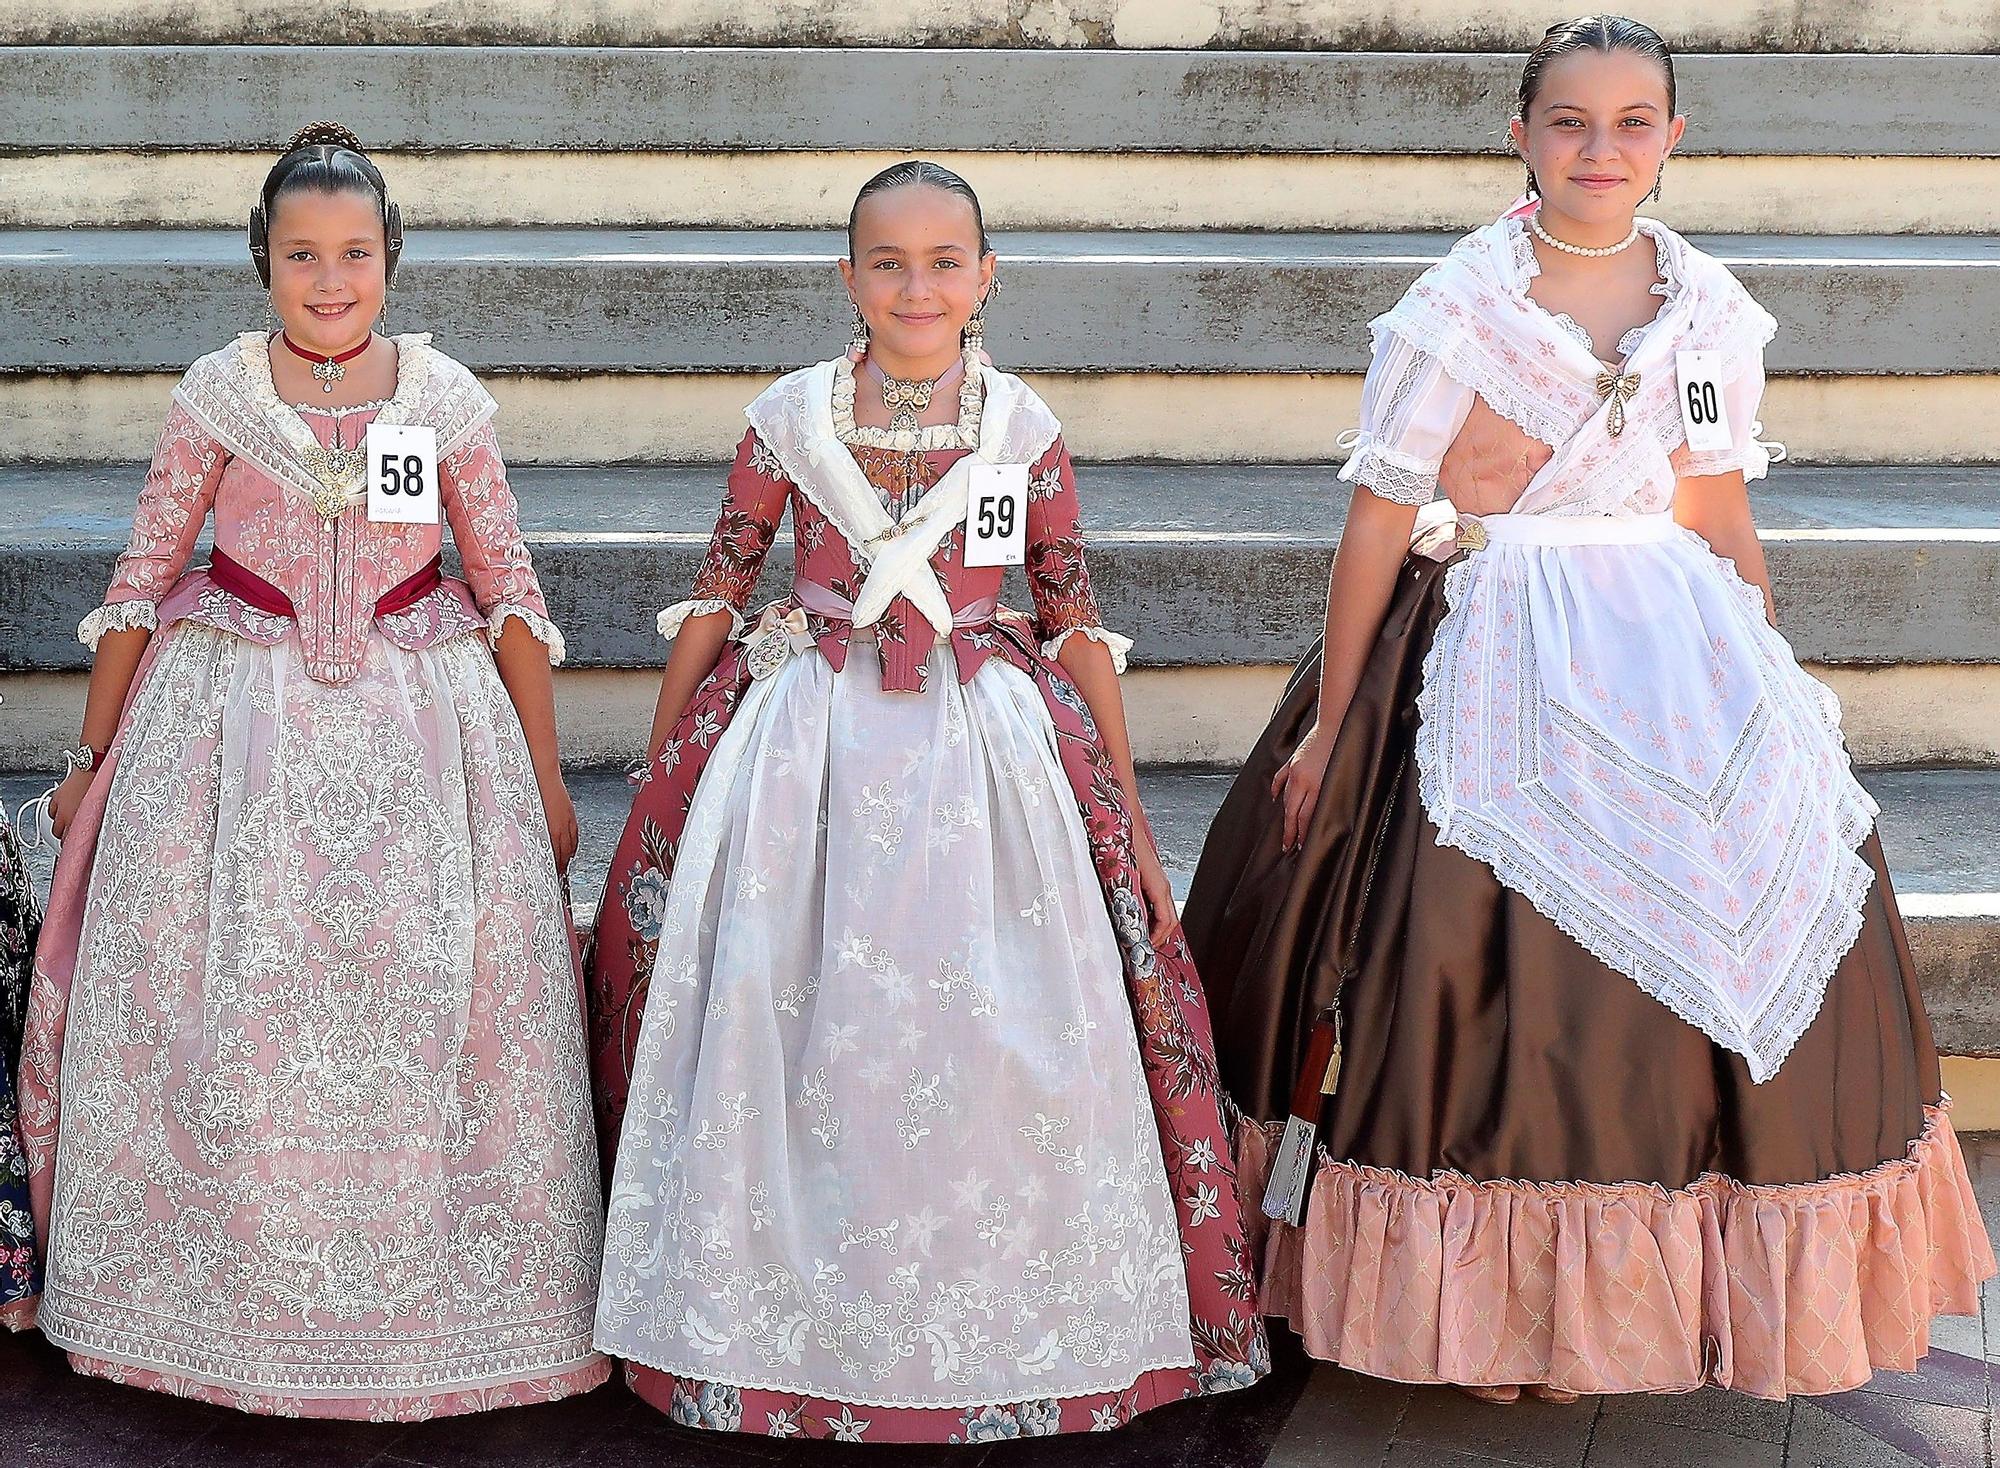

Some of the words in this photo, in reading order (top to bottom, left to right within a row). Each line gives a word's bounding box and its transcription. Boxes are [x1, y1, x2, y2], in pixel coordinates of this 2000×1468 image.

[1687, 380, 1717, 425] 60
[380, 454, 424, 497] 58
[977, 494, 1015, 540] 59
